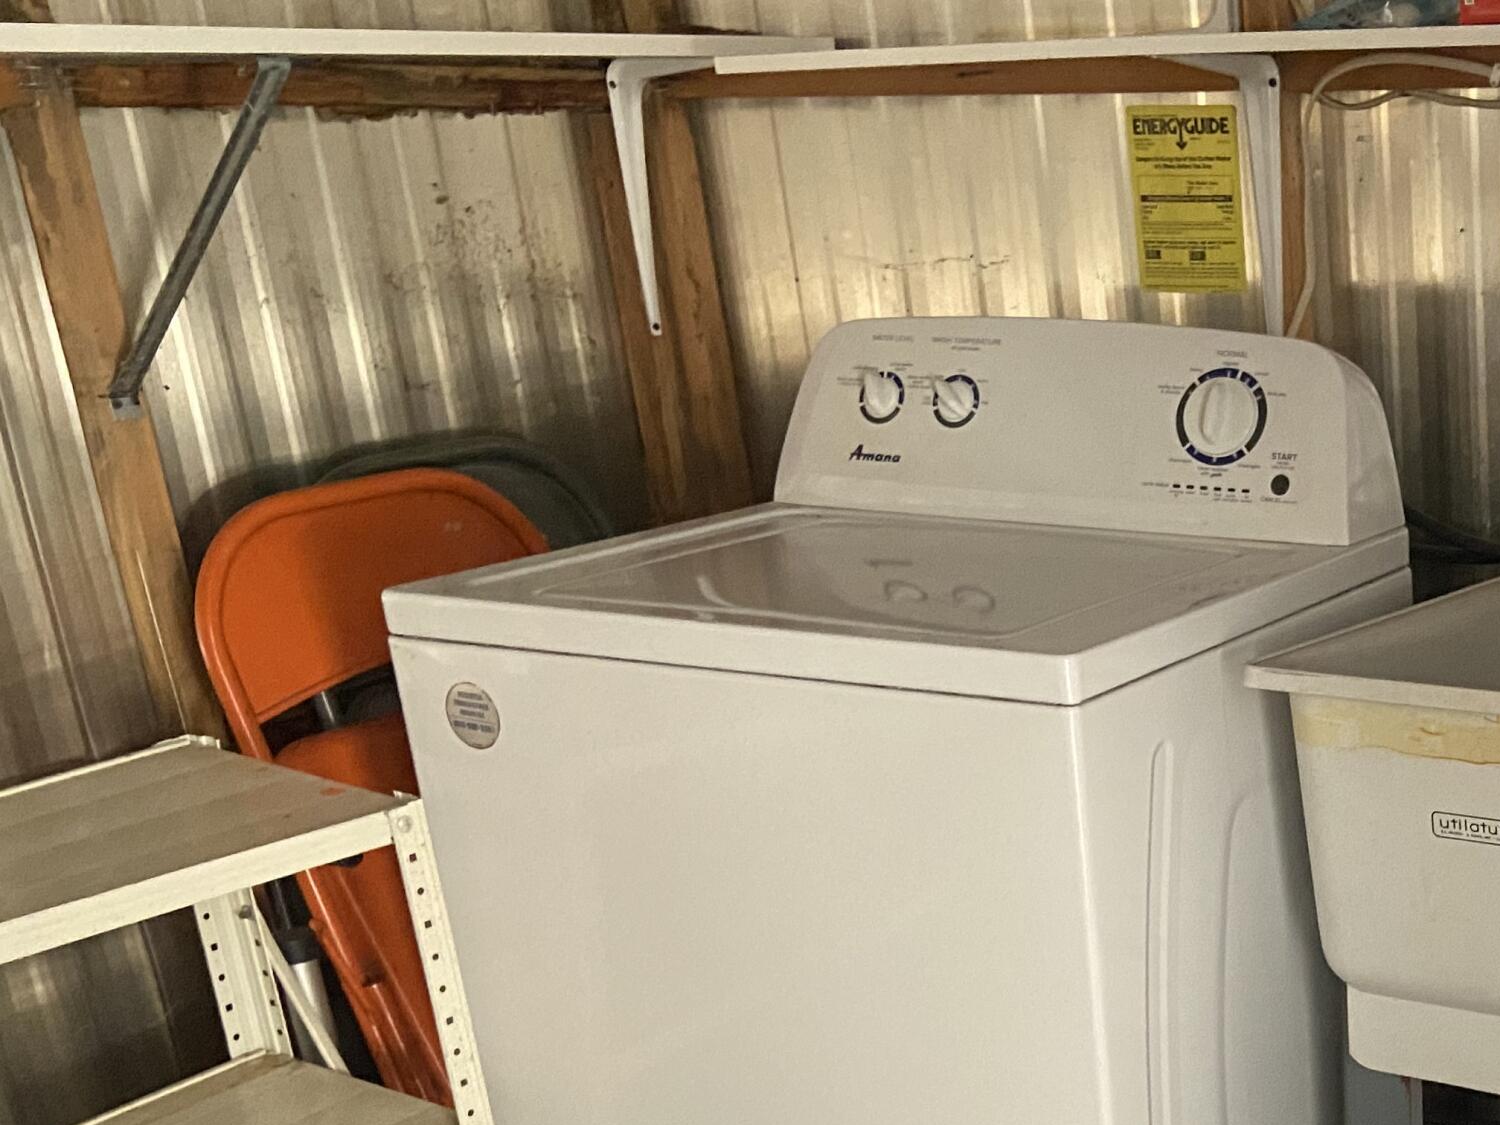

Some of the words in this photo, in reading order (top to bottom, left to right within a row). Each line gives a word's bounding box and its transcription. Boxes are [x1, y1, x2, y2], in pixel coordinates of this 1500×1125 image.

[1132, 116, 1230, 136] ENERGYGUIDE
[848, 443, 901, 463] Amana
[1271, 452, 1298, 461] START
